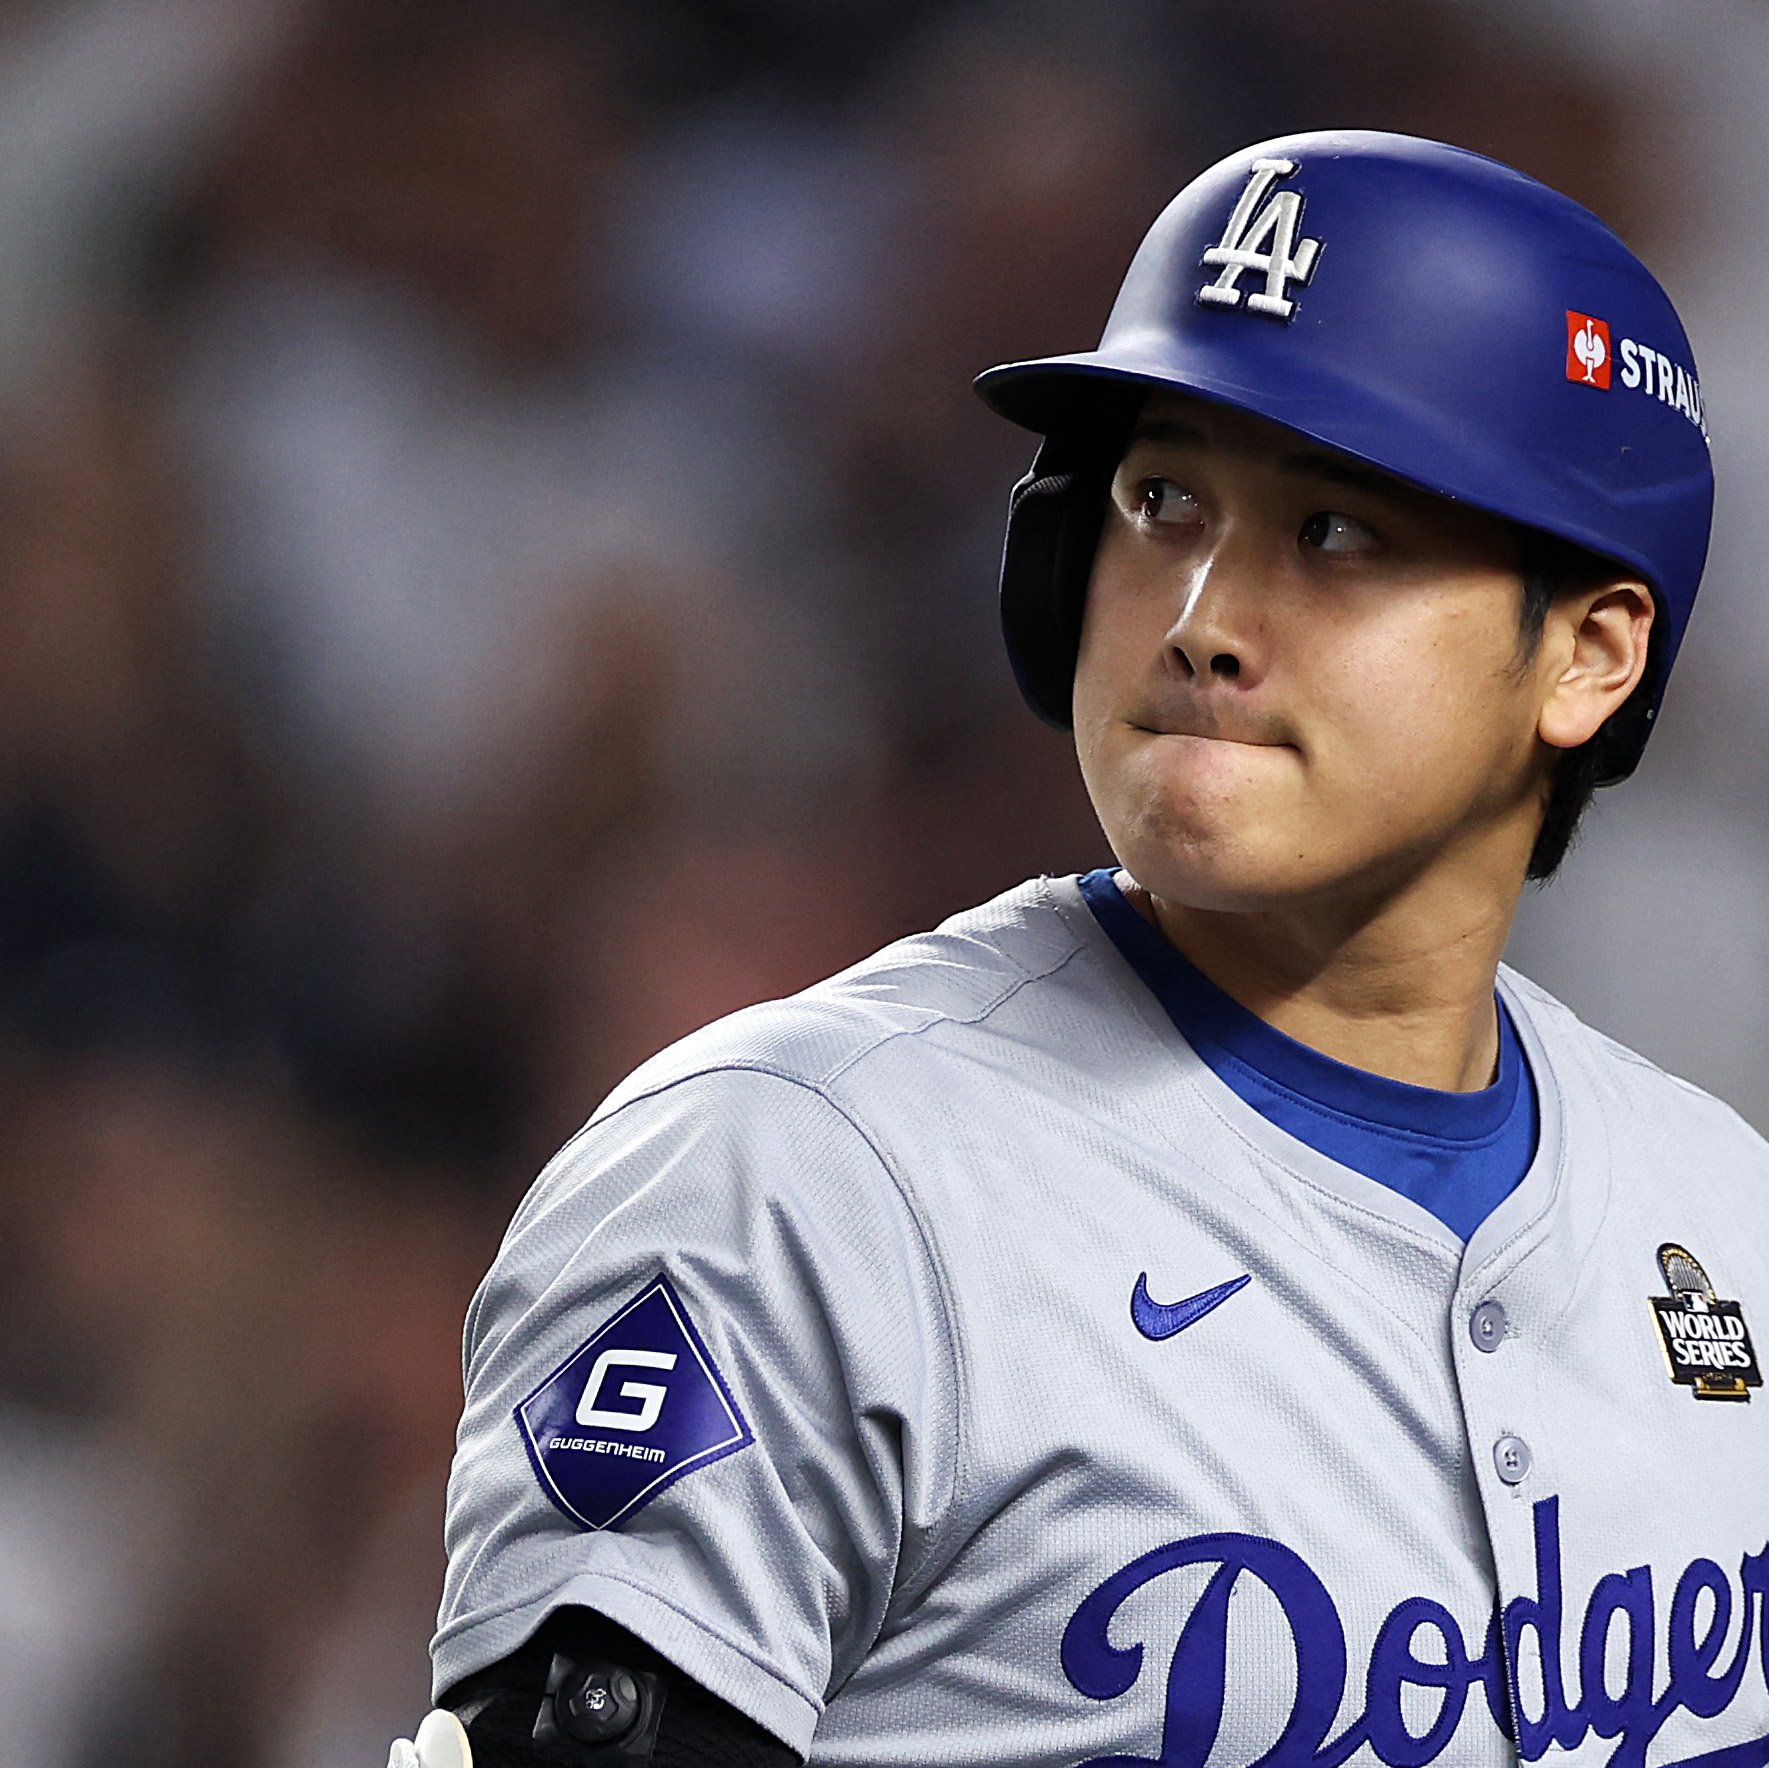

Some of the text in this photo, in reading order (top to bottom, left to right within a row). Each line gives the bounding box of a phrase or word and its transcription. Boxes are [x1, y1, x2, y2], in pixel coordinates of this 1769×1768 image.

[1199, 159, 1320, 317] LA
[1620, 338, 1710, 444] STRAU
[1659, 1310, 1745, 1341] WORLD
[1672, 1338, 1751, 1370] SERIES
[575, 1349, 678, 1432] G
[549, 1437, 666, 1463] GUGGENHEIM
